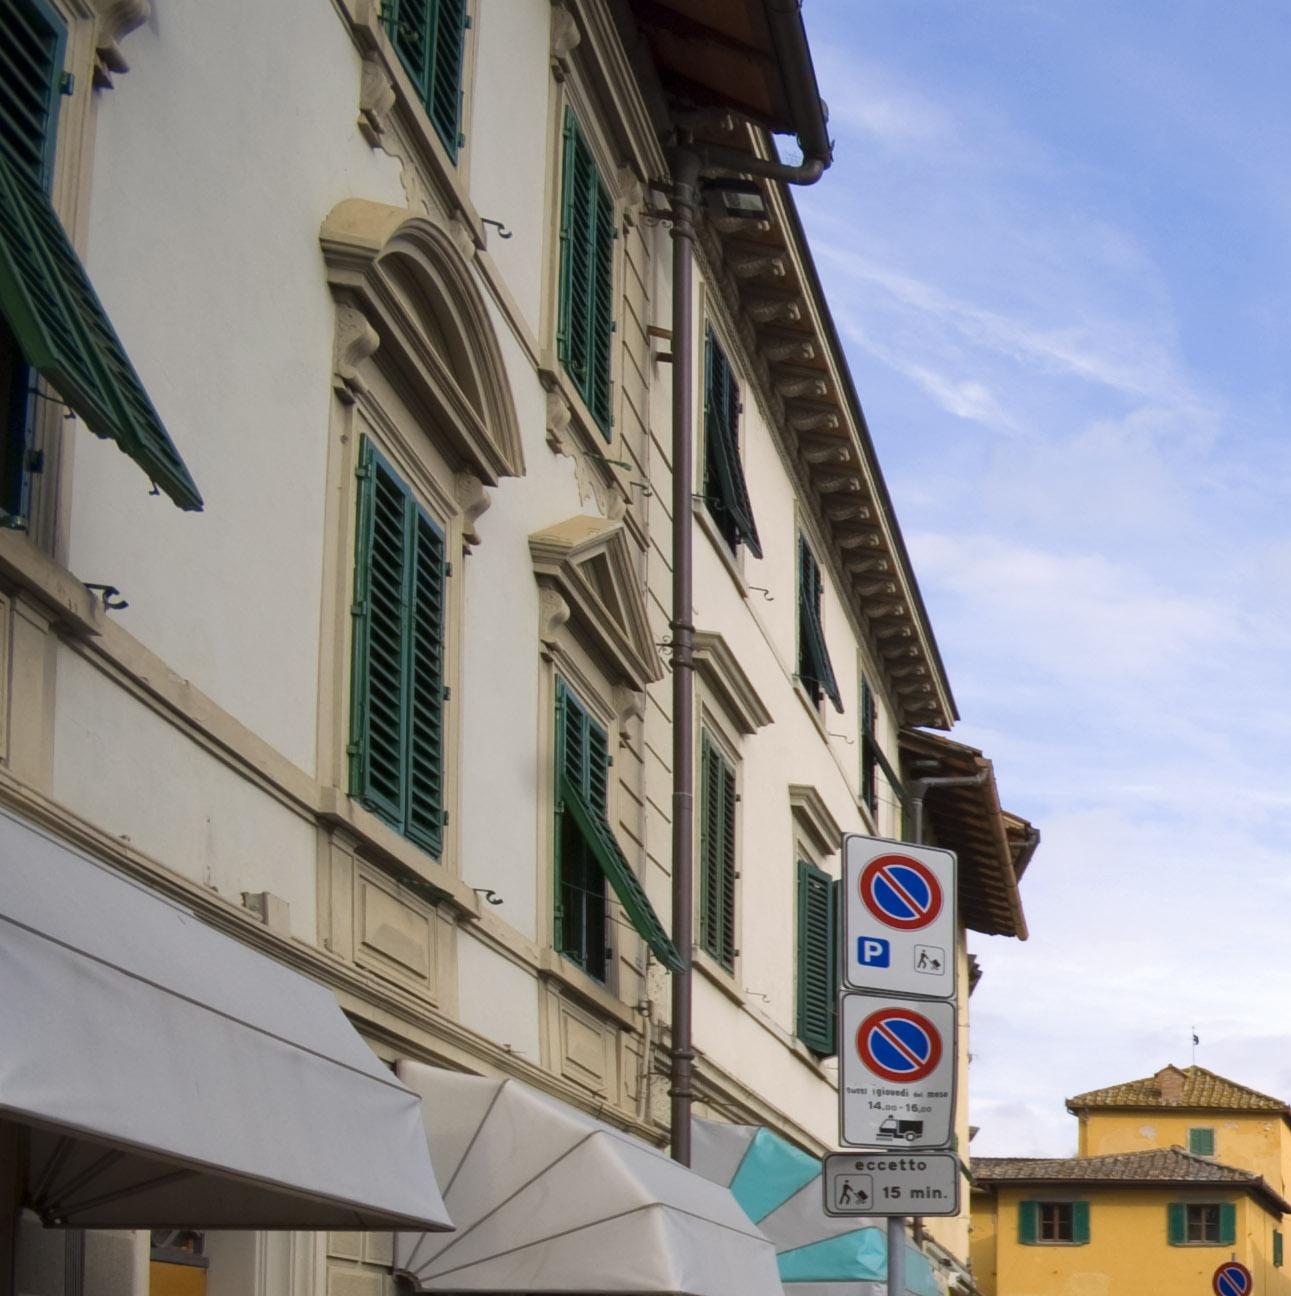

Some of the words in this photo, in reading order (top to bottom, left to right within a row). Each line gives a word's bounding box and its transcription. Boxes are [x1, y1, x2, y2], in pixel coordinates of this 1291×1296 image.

[863, 940, 884, 962] P
[855, 1159, 927, 1171] eccetto
[883, 1186, 901, 1199] 15
[910, 1186, 948, 1199] min.
